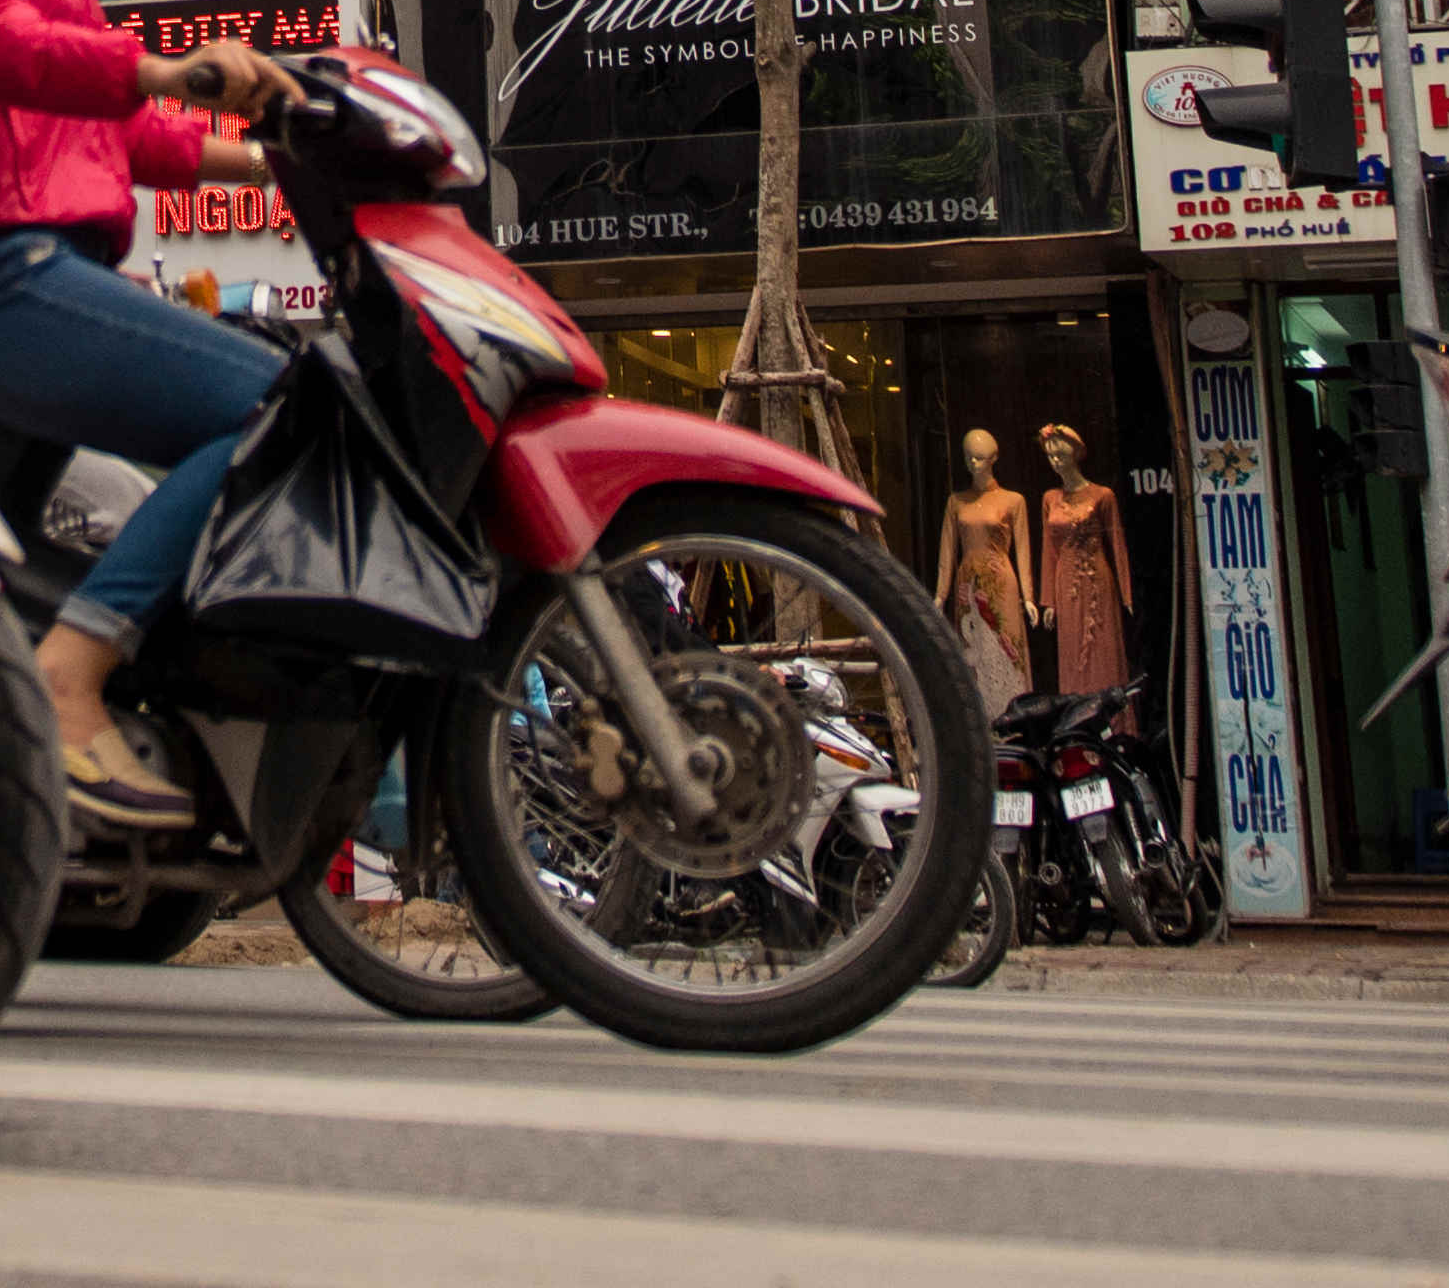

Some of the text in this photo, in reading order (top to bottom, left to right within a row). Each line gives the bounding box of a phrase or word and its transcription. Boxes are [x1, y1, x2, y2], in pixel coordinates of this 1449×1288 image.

[584, 46, 631, 69] THE
[644, 38, 756, 66] SYMBOL
[819, 21, 978, 54] HAPPINESS
[1174, 96, 1199, 111] 10
[154, 184, 297, 242] NGOẠ
[1177, 196, 1231, 218] GIÒ
[1317, 193, 1340, 211] &
[494, 218, 541, 249] 104
[550, 214, 620, 245] HUE
[1169, 221, 1238, 243] 102
[1191, 363, 1258, 442] CƠM
[1130, 468, 1173, 495] 104
